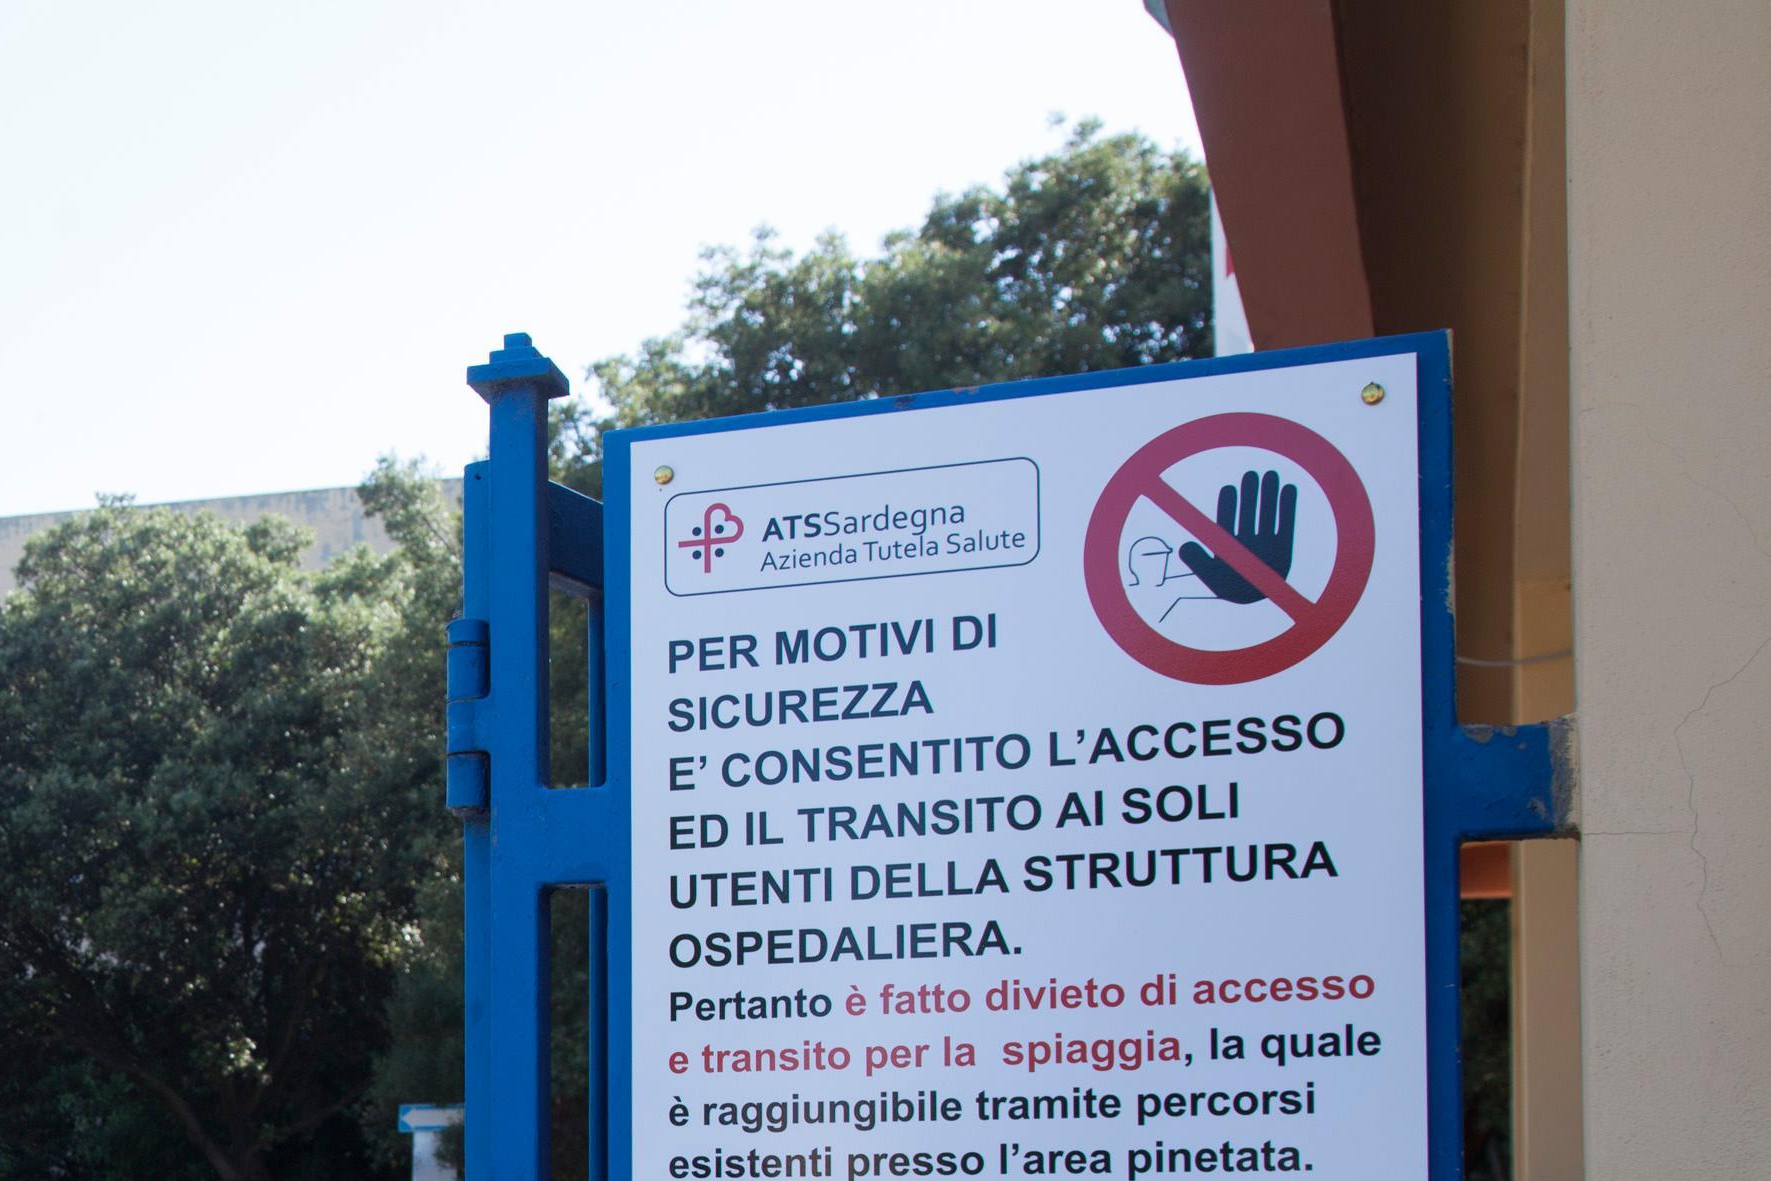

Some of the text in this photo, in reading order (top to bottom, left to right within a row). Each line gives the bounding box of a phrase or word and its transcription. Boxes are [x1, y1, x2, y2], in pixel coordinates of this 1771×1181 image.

[760, 529, 1025, 572] Azienda Tutela Salute
[669, 613, 996, 674] PER MOTIVI DI
[668, 680, 934, 732] SICUREZZA
[670, 712, 1346, 791] E’ CONSENTITO L’ACCESSO
[670, 781, 1239, 850] ED IL TRANSITO AI SOLI
[670, 841, 1339, 909] UTENTI DELLA STRUTTURA
[669, 920, 1022, 968] OSPEDALIERA.
[670, 974, 1374, 1022] Pertanto è fatto divieto di accesso
[669, 1024, 1382, 1076] e transito per la spiaggia, la quale
[669, 1081, 1315, 1133] è raggiungibile tramite percorsi
[669, 1146, 831, 1179] esistenti
[1000, 1143, 1112, 1175] l’area
[1128, 1140, 1313, 1181] pinetata.
